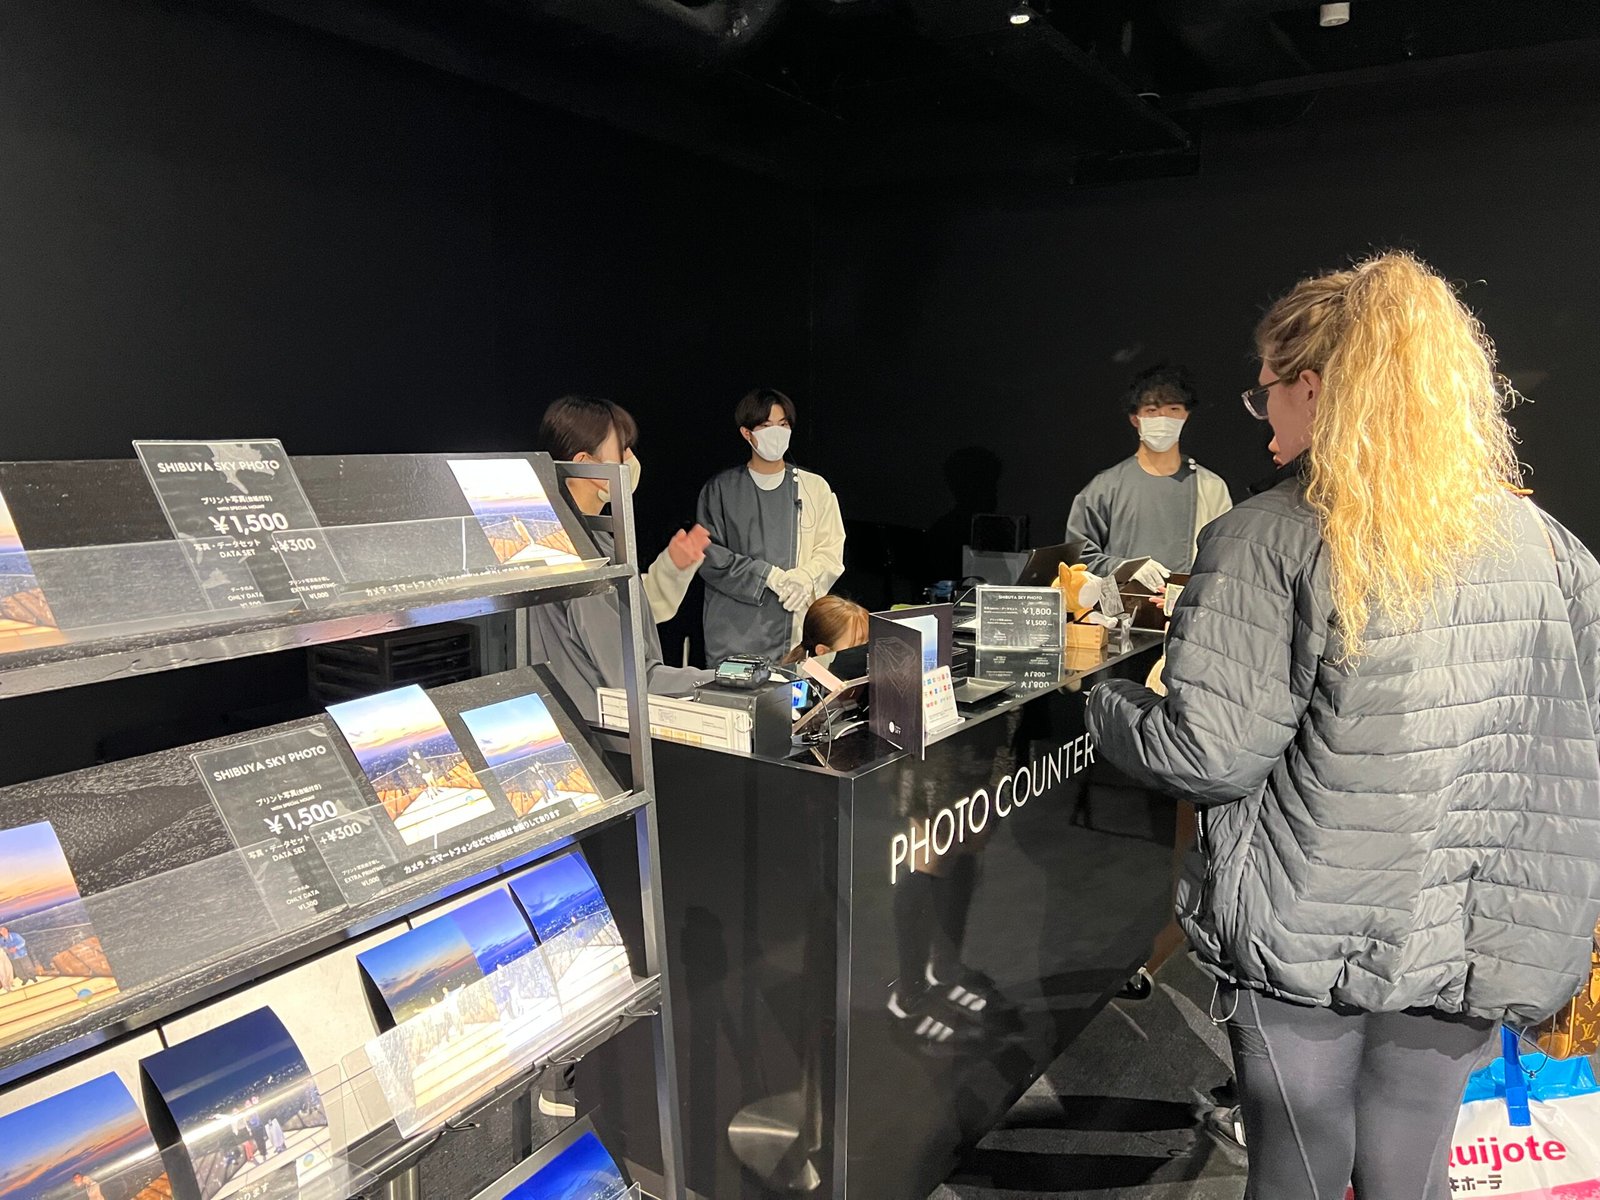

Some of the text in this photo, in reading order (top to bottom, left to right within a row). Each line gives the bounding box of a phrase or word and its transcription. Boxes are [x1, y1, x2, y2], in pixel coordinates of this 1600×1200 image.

[157, 460, 280, 473] SHIBUYA SKY PHOTO
[208, 512, 289, 535] ¥1,500
[219, 548, 256, 558] DATA SET
[270, 537, 316, 554] +¥300
[246, 591, 264, 600] DATA
[1022, 607, 1052, 616] ¥1,800
[213, 745, 327, 782] SHIBUYA SKY PHOTO
[891, 732, 1095, 885] PHOTO COUNTER
[263, 800, 338, 835] ¥1,500
[319, 821, 362, 845] +¥300
[272, 845, 307, 861] DATA SET
[302, 889, 320, 900] DATA
[1448, 1135, 1566, 1172] uijote
